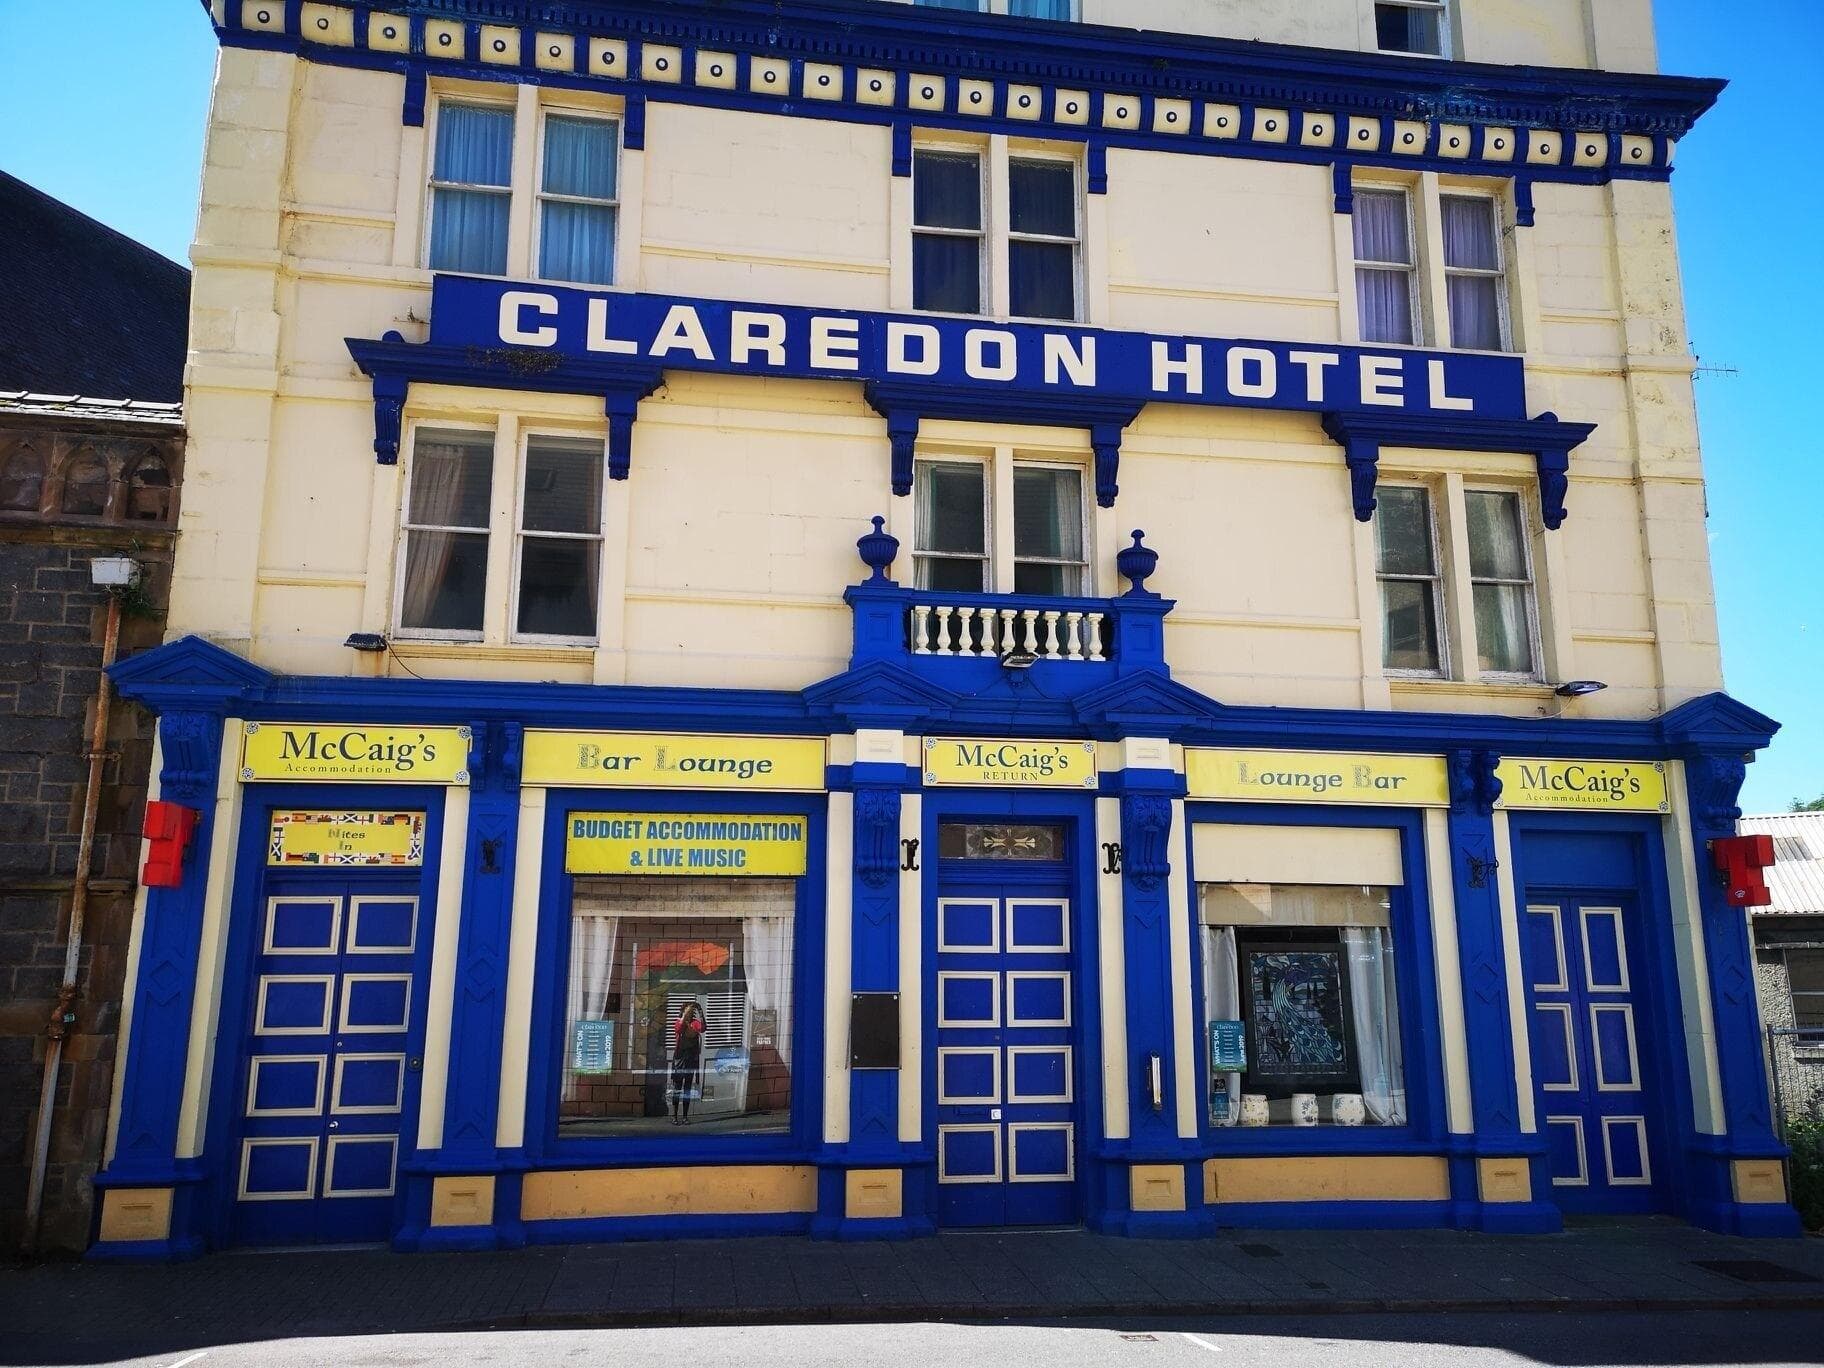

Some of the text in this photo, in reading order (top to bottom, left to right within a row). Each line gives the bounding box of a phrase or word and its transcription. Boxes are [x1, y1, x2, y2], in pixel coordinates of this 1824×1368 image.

[499, 291, 1473, 411] CLAREDON HOTEL
[279, 731, 436, 771] McCaig's
[576, 744, 773, 778] Bar Lounge
[956, 744, 1068, 775] McCaig's
[285, 763, 391, 773] Accommodation
[983, 771, 1039, 781] RETURN
[1237, 761, 1407, 792] Lounge Bar
[1519, 765, 1640, 800] McCaig's
[1526, 793, 1608, 803] Accommodation
[573, 820, 802, 841] BUDGET ACCOMMODATION
[630, 848, 746, 867] & LIVE MUSIC
[577, 1030, 584, 1041] ON
[1213, 1030, 1220, 1040] ON
